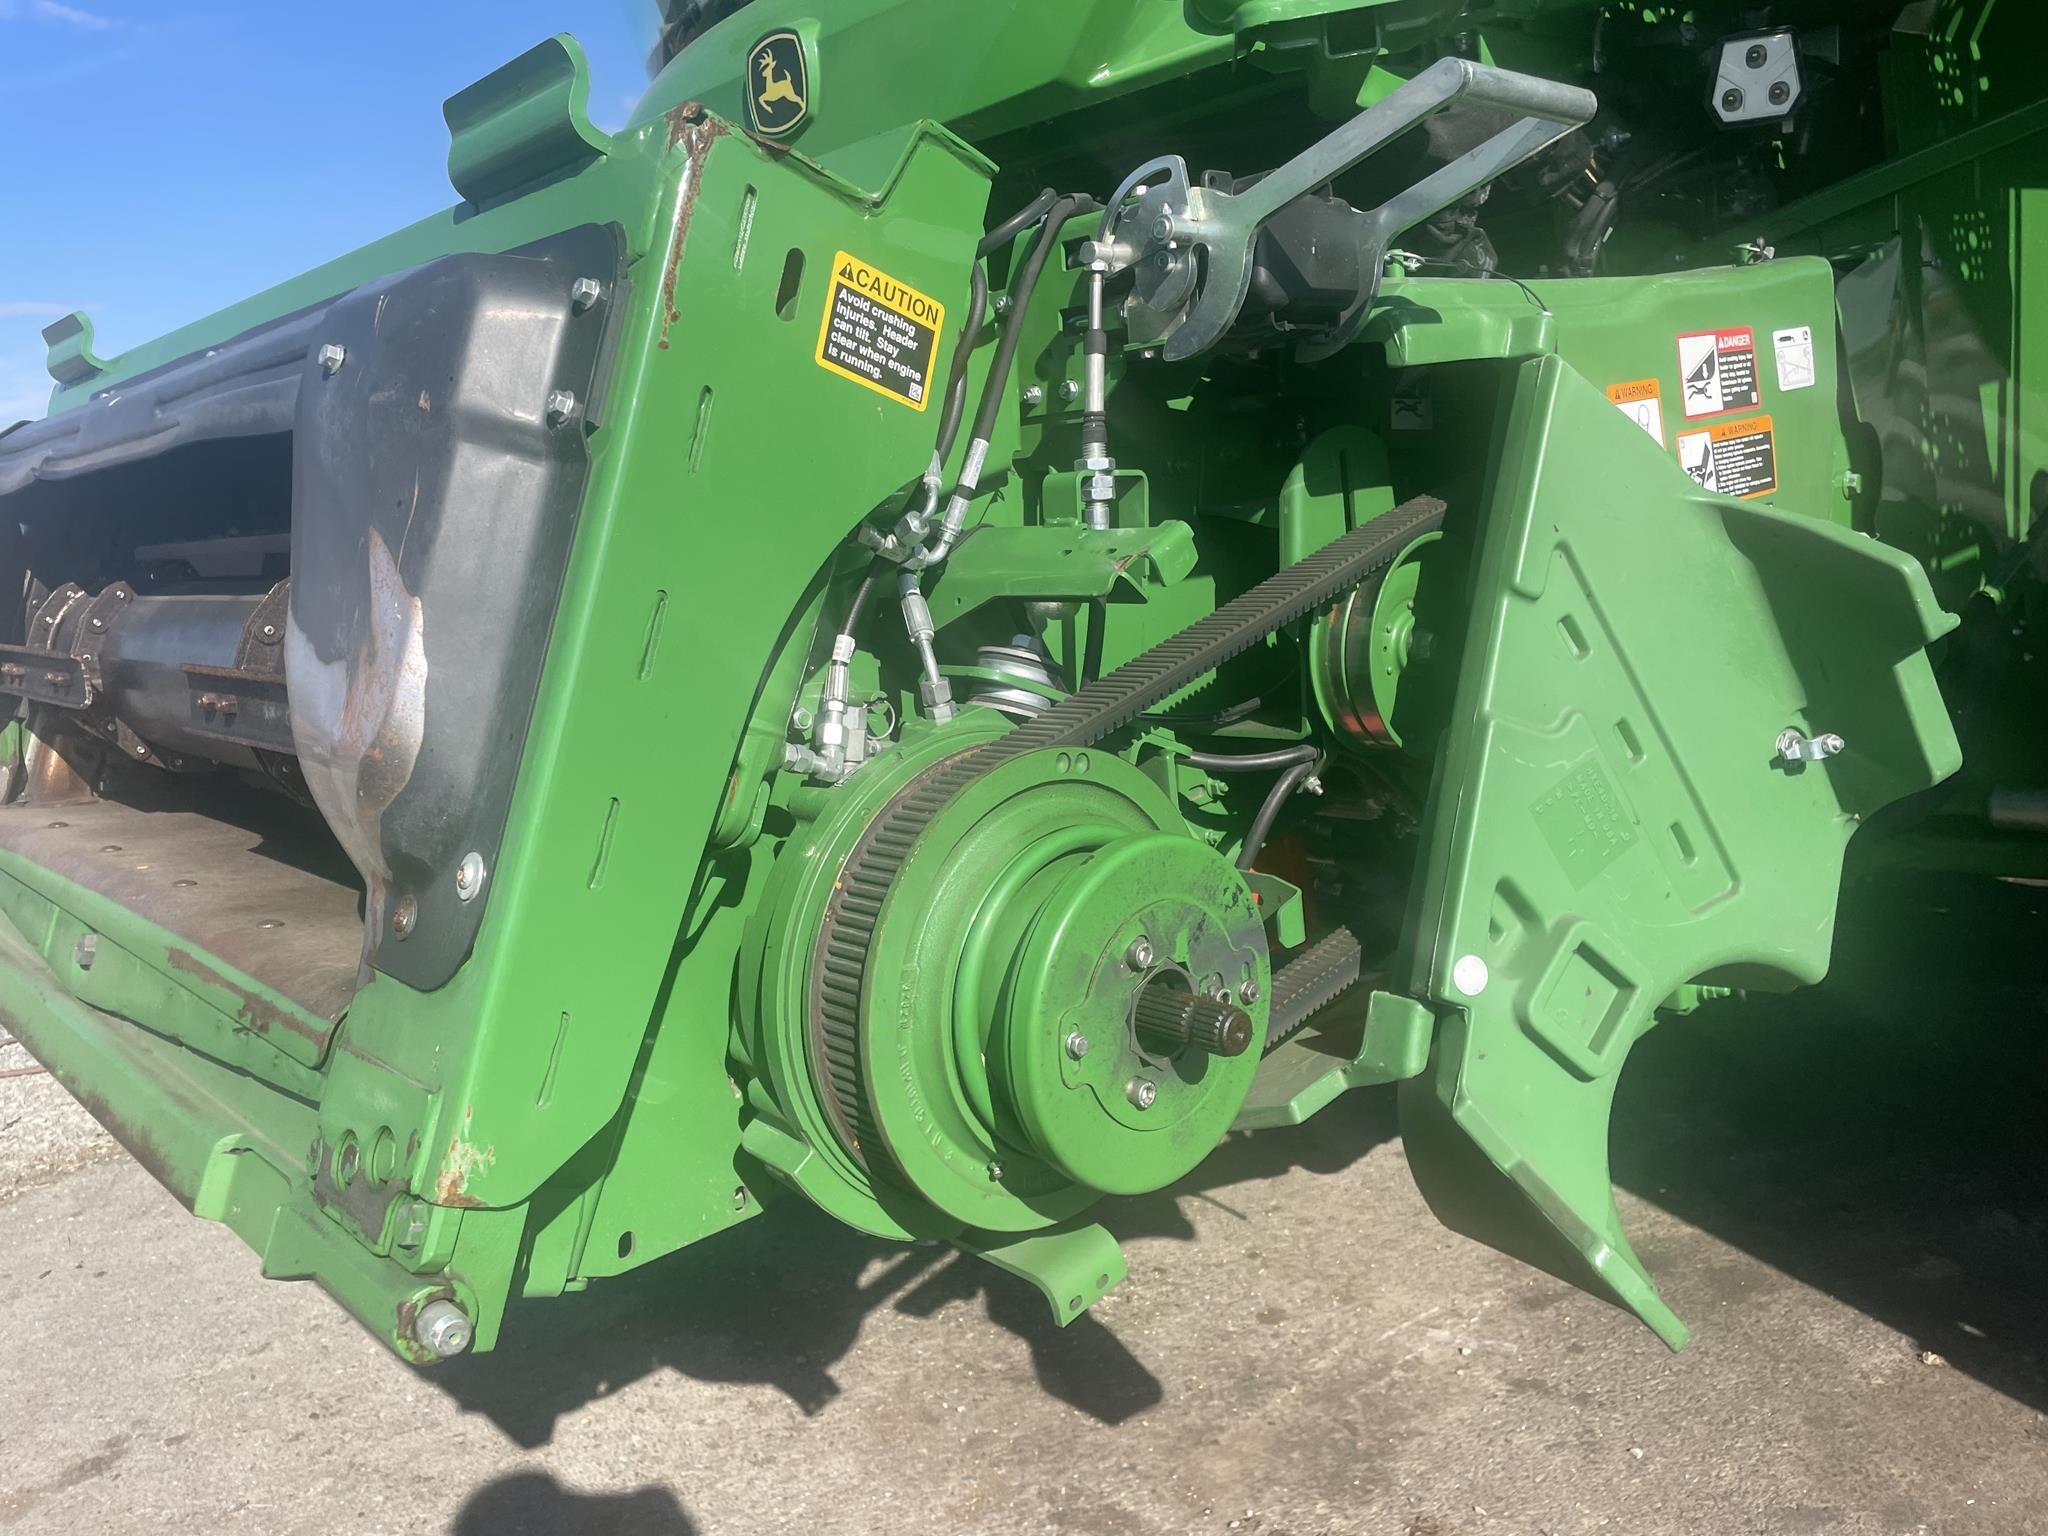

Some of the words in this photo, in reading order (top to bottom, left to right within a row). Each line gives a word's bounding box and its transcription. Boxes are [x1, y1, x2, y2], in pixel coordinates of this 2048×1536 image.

[839, 288, 870, 312] Avoid
[871, 306, 916, 337] crushing
[856, 269, 939, 325] CAUTION
[833, 318, 853, 334] can
[855, 326, 871, 343] tilt.
[876, 336, 899, 358] Stay
[836, 301, 877, 331] injuries.
[882, 324, 918, 350] Header
[1723, 334, 1751, 348] DANGER
[828, 343, 838, 357] is
[840, 351, 882, 379] running.
[831, 332, 857, 350] clear
[859, 345, 886, 365] when
[888, 359, 921, 381] engine
[1620, 383, 1653, 400] WARNING
[1728, 421, 1758, 435] WARNING
